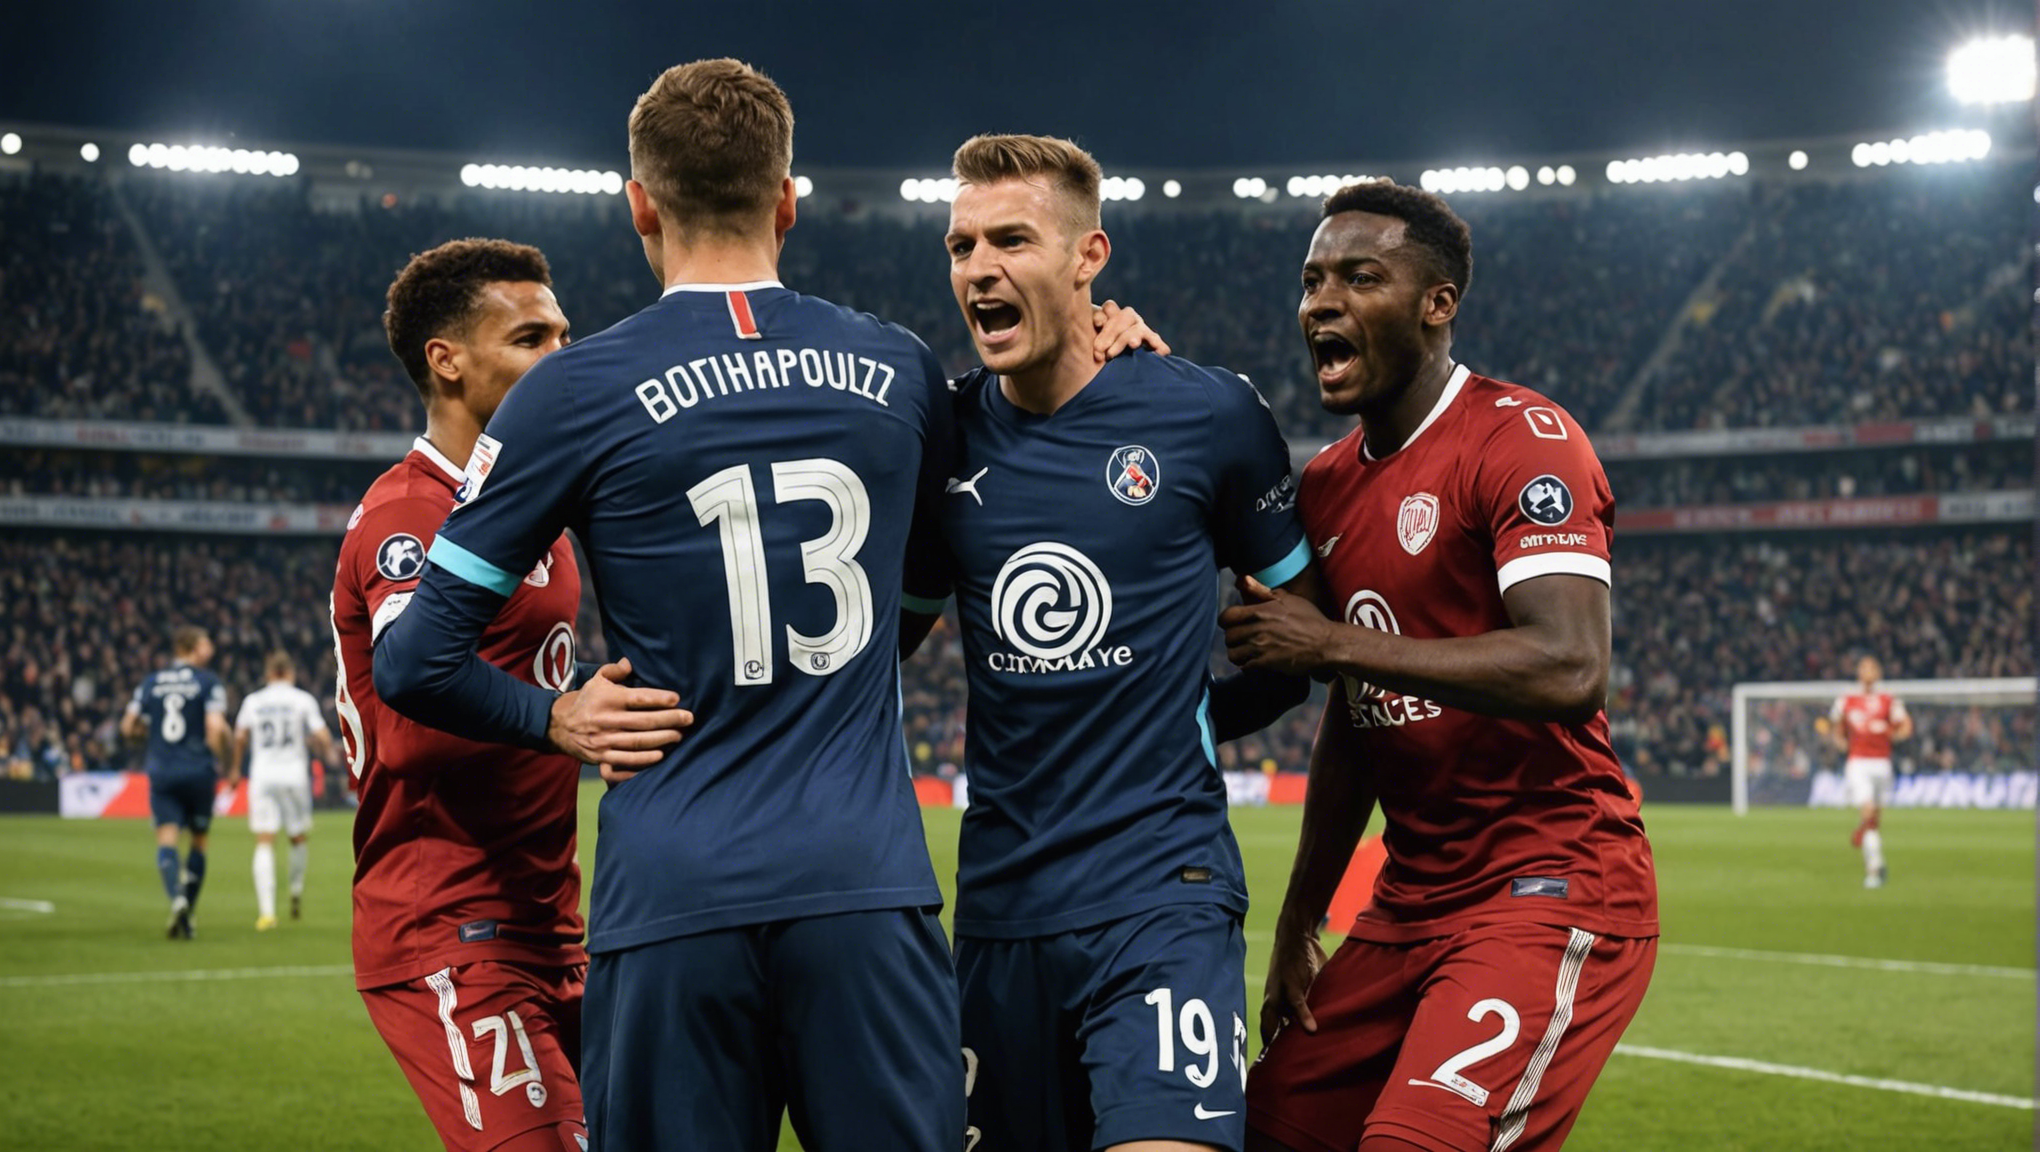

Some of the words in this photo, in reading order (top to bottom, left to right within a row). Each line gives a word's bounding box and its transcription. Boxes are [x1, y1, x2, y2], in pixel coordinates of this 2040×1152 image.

[686, 457, 874, 686] 13
[1145, 988, 1218, 1088] 19
[1430, 997, 1521, 1107] 2
